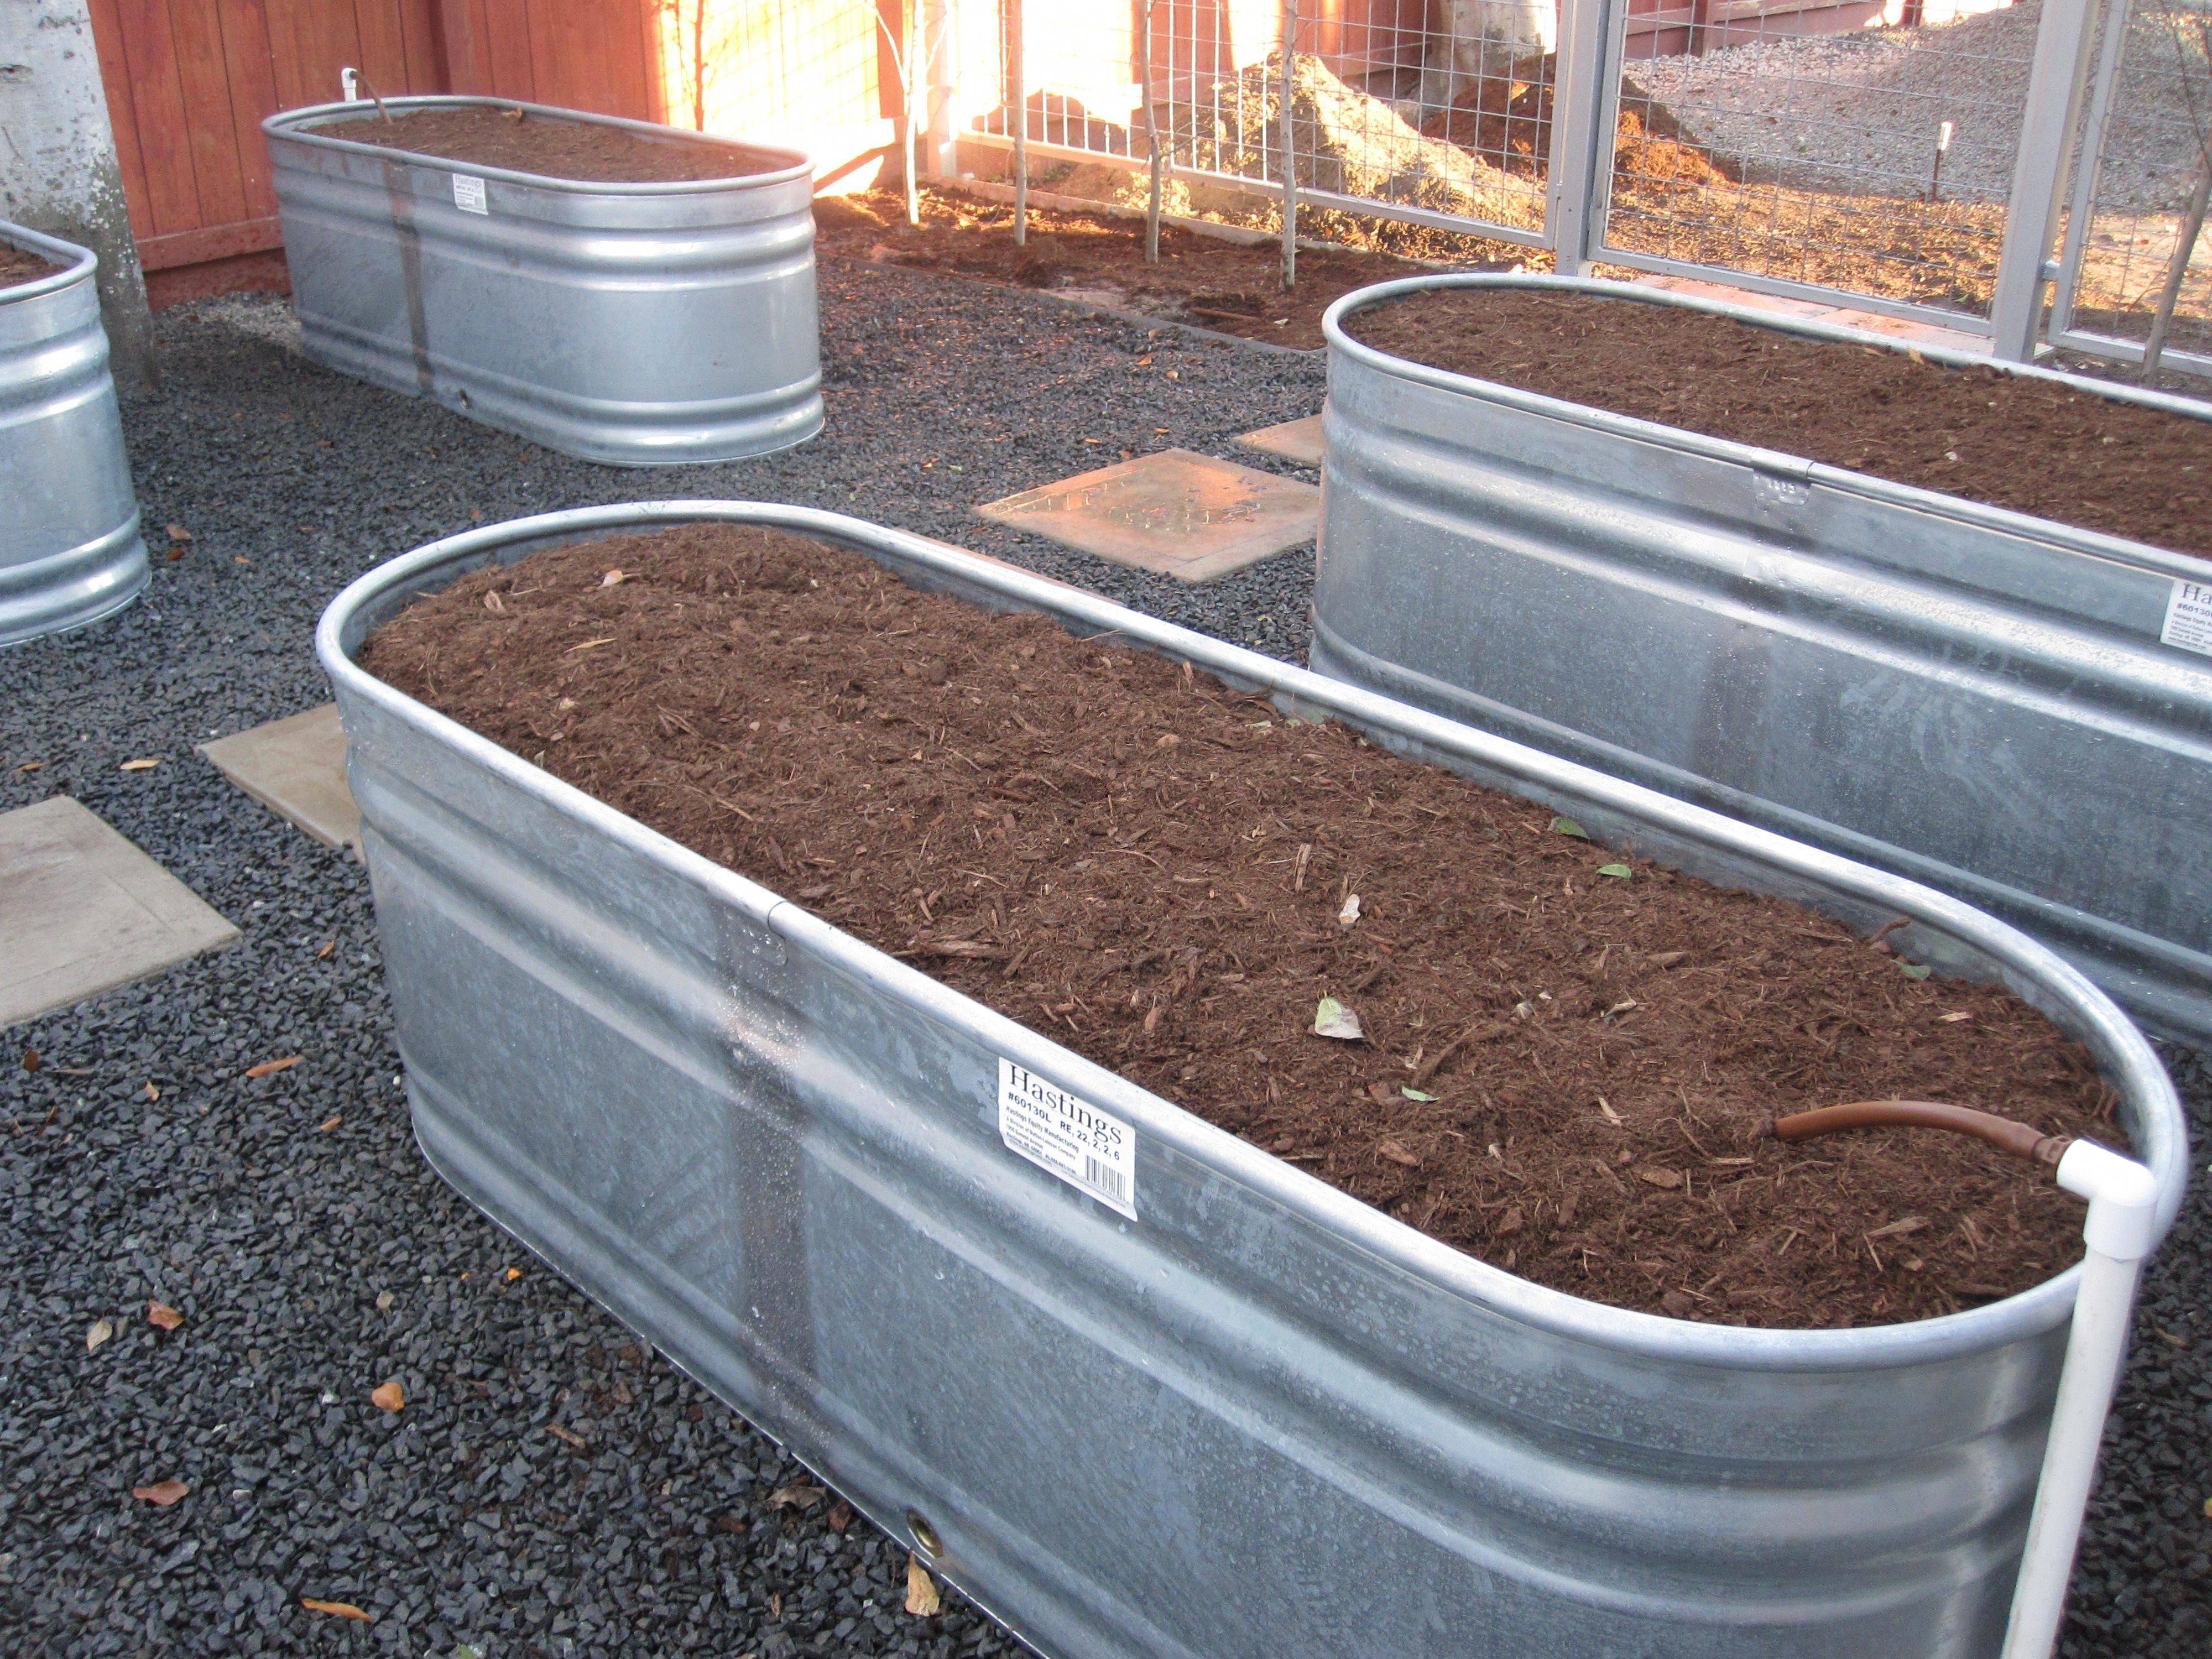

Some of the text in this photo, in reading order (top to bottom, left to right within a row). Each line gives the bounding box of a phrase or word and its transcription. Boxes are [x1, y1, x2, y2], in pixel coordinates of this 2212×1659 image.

[1008, 1091, 1120, 1161] #60130L RE, 22, 2, 2, 6
[1009, 1063, 1122, 1145] Hastings
